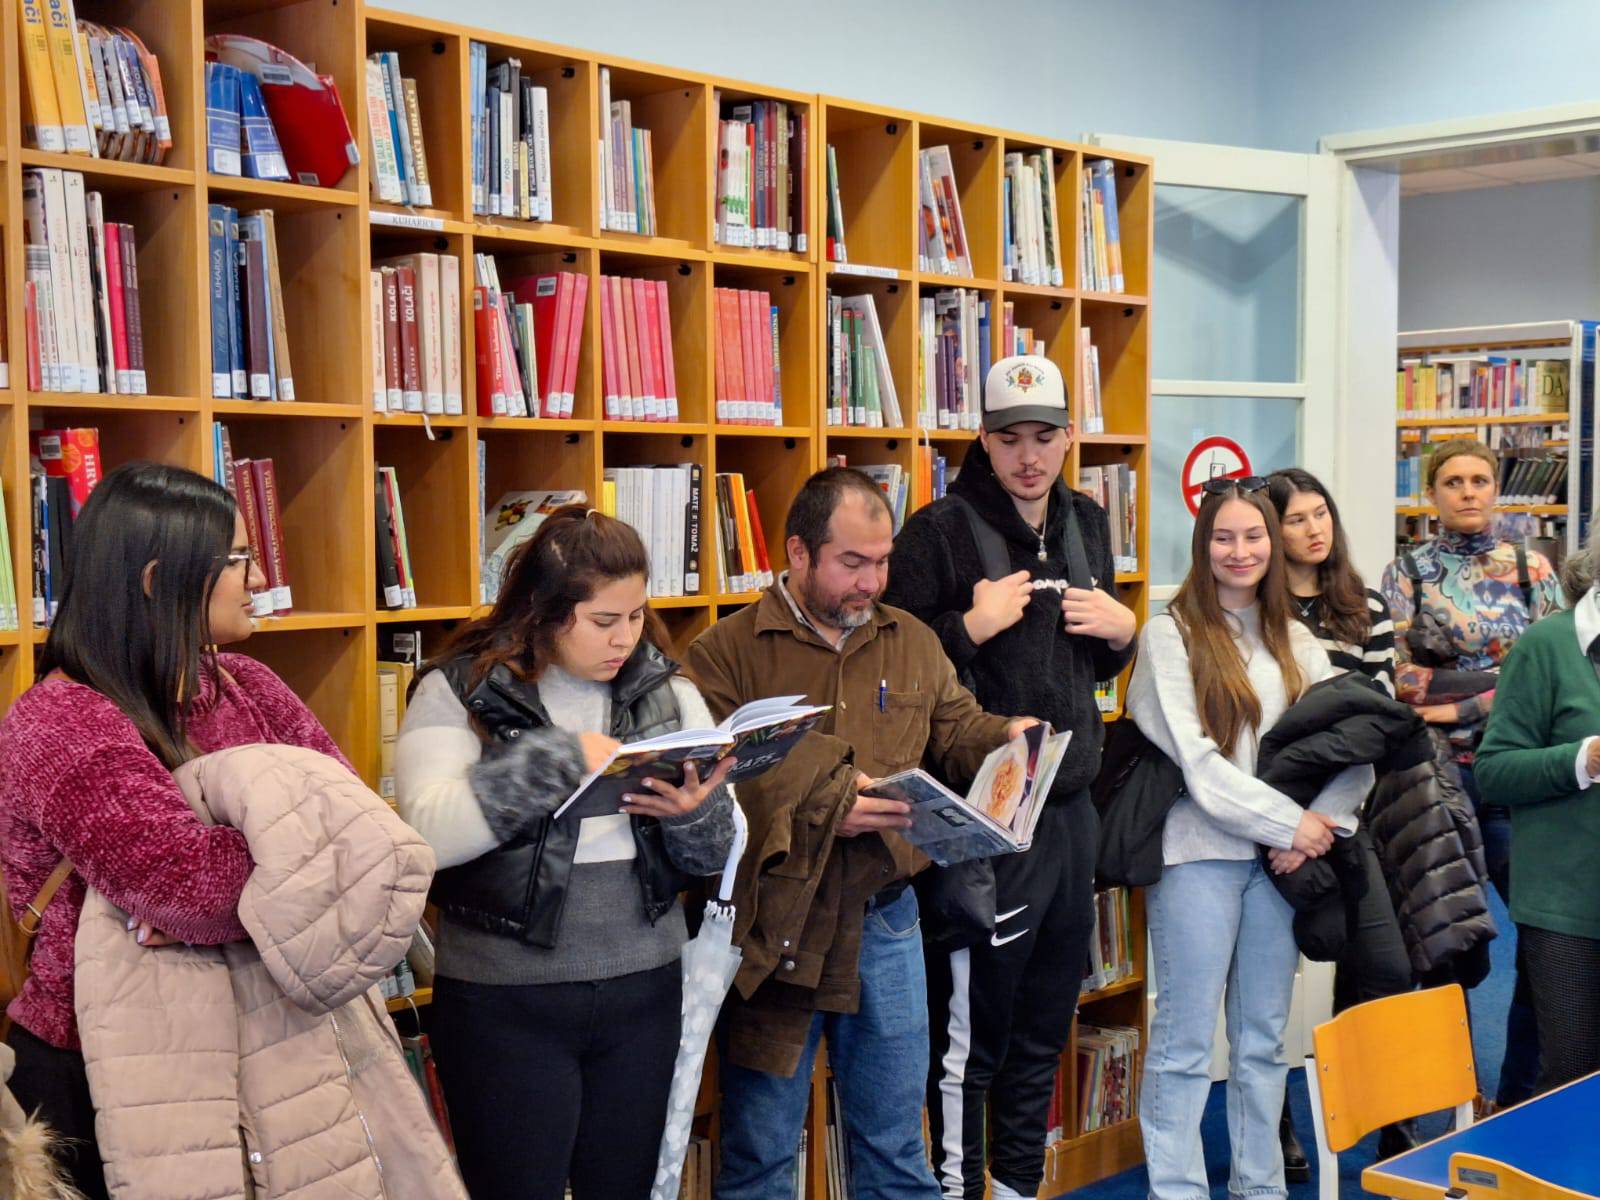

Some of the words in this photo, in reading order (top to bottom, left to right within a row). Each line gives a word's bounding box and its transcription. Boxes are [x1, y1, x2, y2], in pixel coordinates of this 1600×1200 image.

[132, 66, 147, 106] KOLAČI
[388, 285, 397, 322] KOLAČI
[402, 286, 415, 322] KOLAČI
[84, 453, 98, 494] HRV
